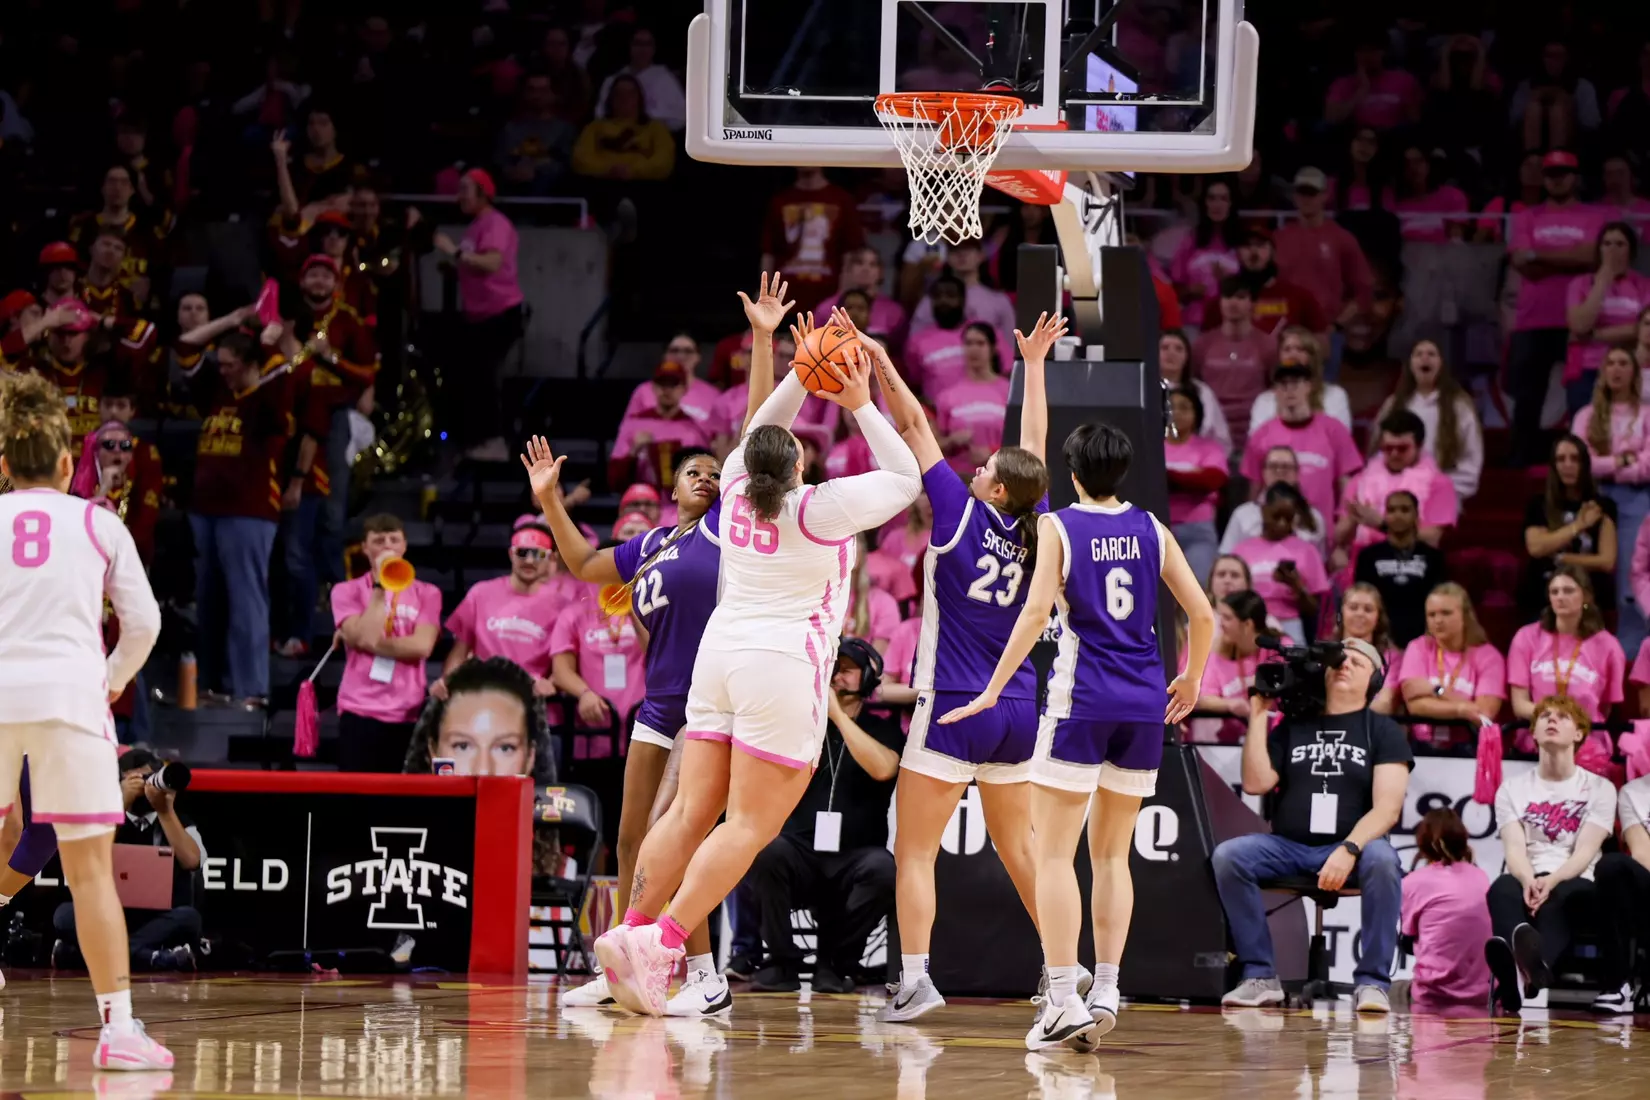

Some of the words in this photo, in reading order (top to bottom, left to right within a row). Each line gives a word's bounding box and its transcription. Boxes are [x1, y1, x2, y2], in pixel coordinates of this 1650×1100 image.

[723, 128, 773, 141] SPALDING
[12, 509, 52, 569] 8
[729, 494, 779, 555] 55
[1091, 535, 1141, 562] GARCIA
[635, 569, 670, 617] 22
[967, 553, 1024, 608] 23
[1105, 566, 1135, 621] 6
[1291, 743, 1367, 767] STATE
[326, 858, 468, 909] STATE
